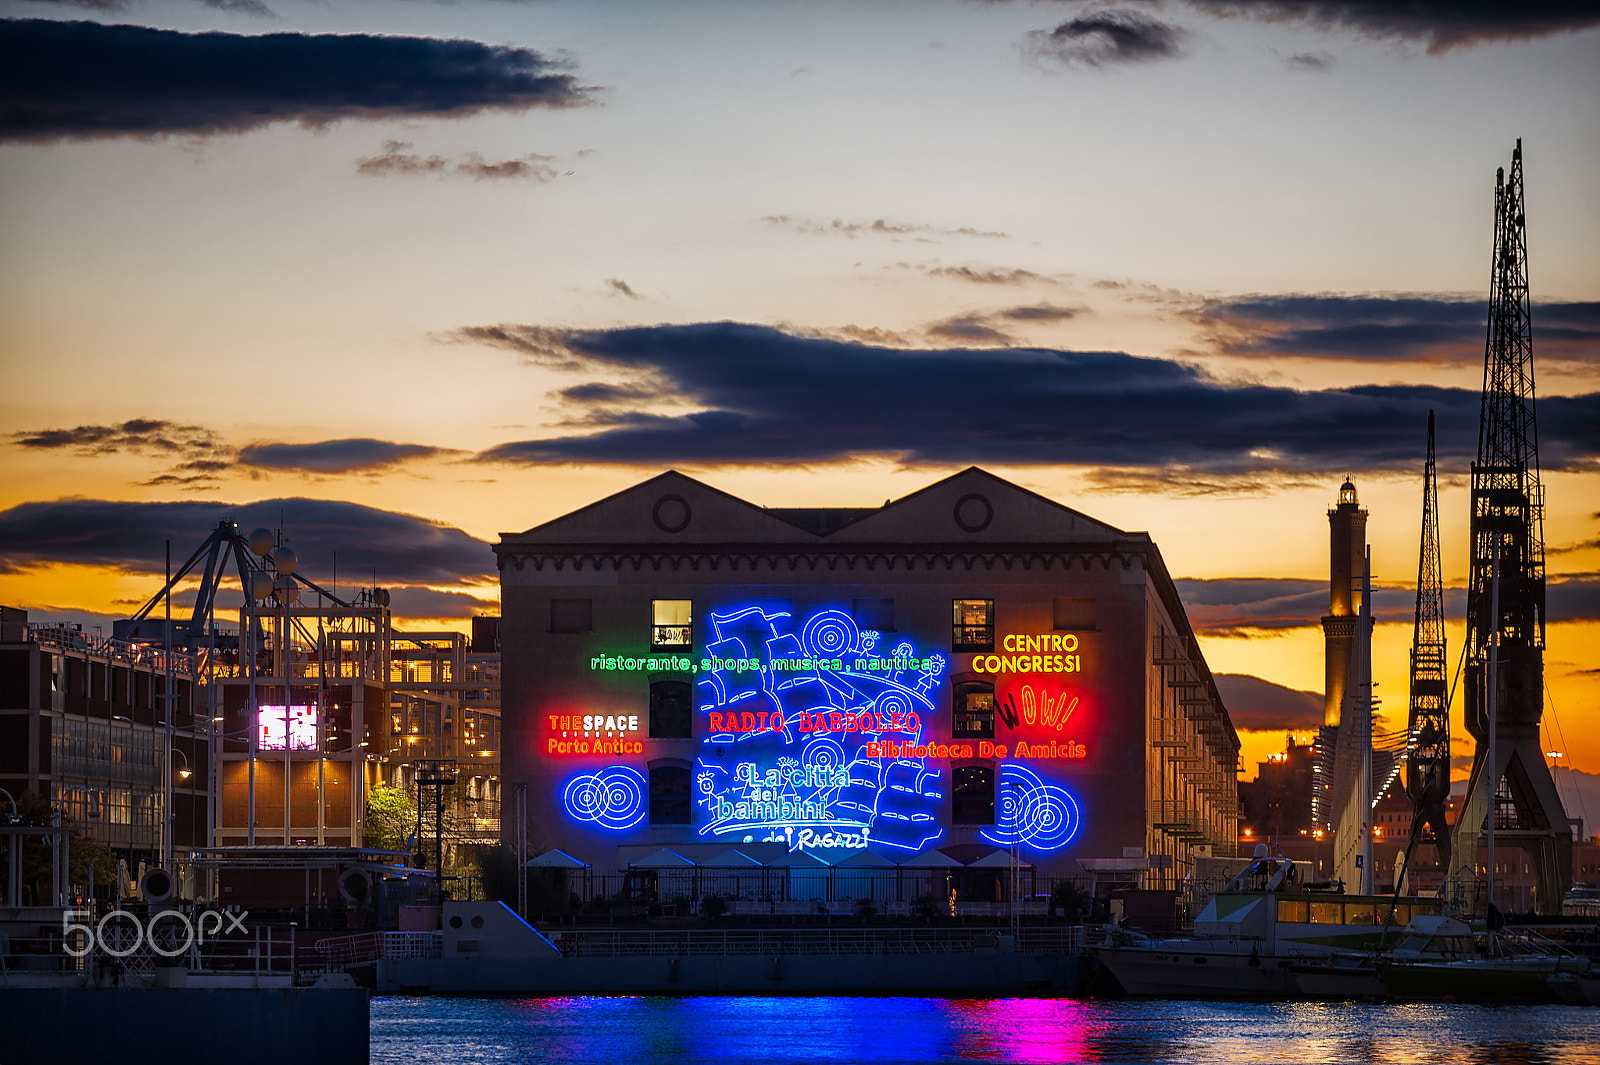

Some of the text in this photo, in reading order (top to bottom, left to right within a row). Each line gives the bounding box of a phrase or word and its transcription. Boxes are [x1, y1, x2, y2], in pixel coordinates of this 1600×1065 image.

[1003, 634, 1079, 652] CENTRO
[591, 654, 698, 673] ristorante,
[701, 656, 768, 673] shops,
[854, 655, 933, 671] nautica
[972, 655, 1081, 673] CONGRESSI
[994, 685, 1079, 730] WOW!
[708, 712, 921, 732] RADIO BABBOLEO
[548, 738, 643, 754] Porto Antico
[866, 740, 1087, 758] Biblioteca De Amicis
[749, 763, 851, 788] La città
[750, 786, 778, 801] dei
[717, 795, 826, 819] bambini
